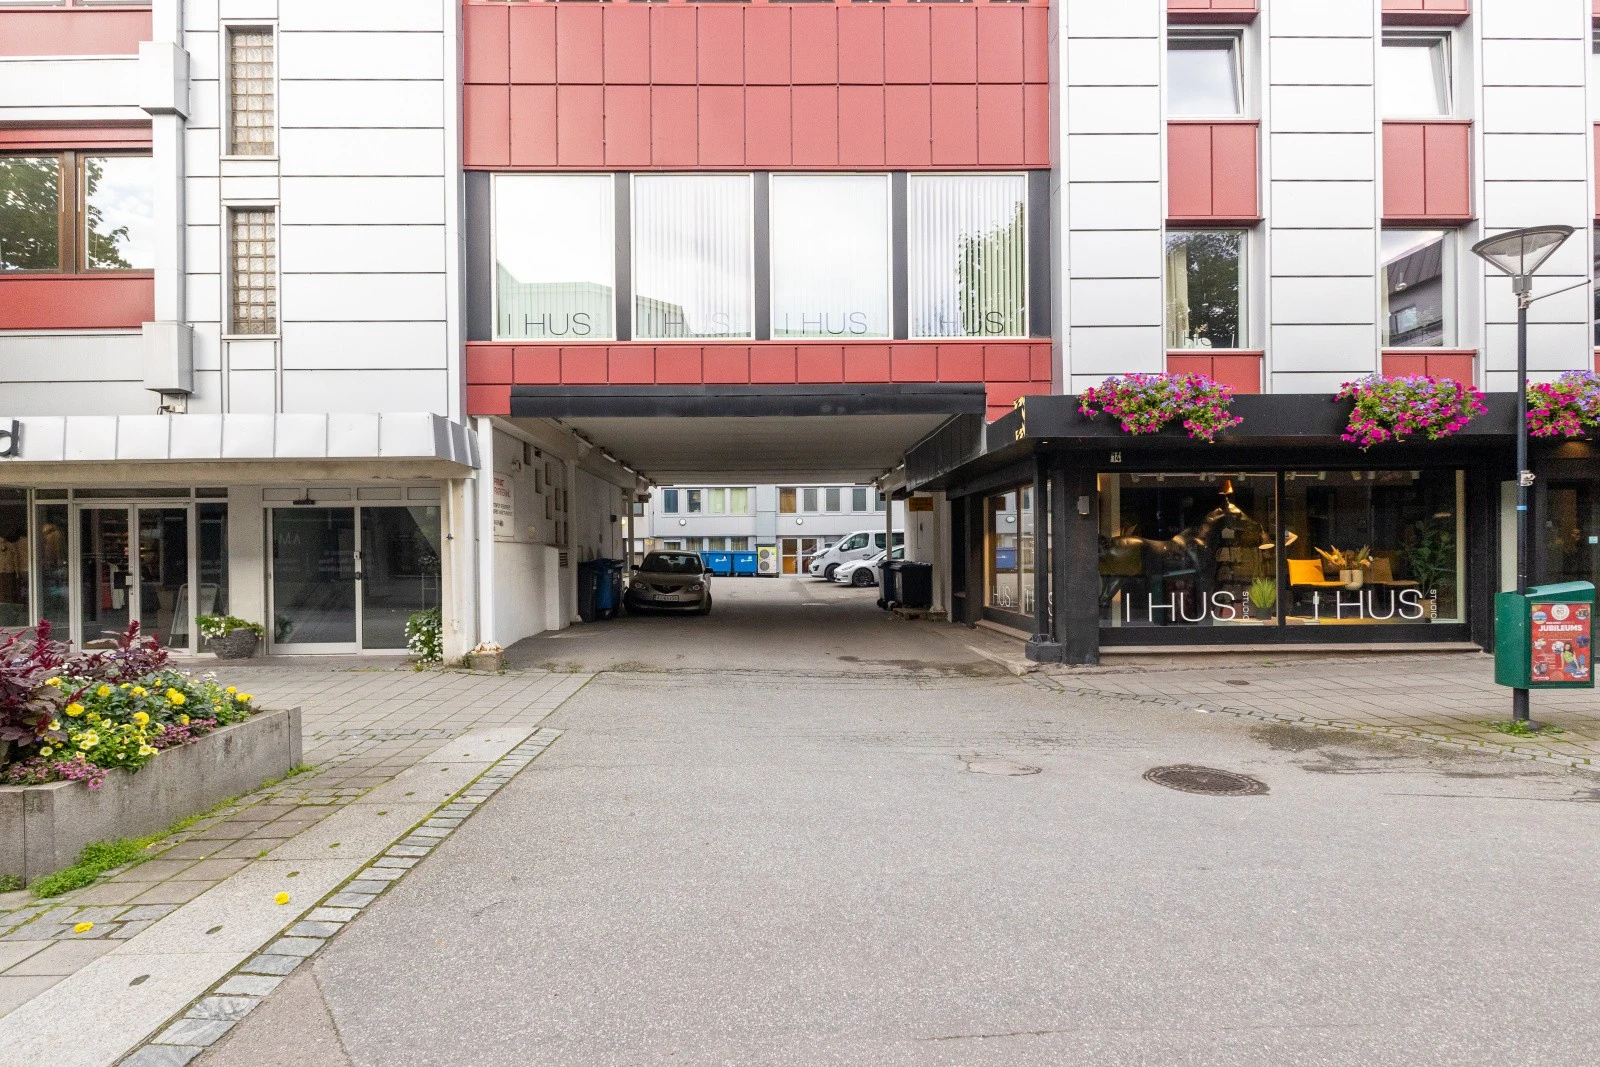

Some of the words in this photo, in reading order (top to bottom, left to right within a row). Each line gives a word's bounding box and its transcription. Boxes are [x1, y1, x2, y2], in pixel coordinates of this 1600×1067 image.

[525, 312, 591, 336] HUS
[664, 312, 730, 335] HUS
[802, 312, 868, 334] HUS
[1126, 592, 1131, 622] I
[1148, 590, 1236, 622] HUS
[1314, 590, 1319, 620] I
[1336, 588, 1424, 620] HUS
[1538, 624, 1583, 632] JUBILEUMS
